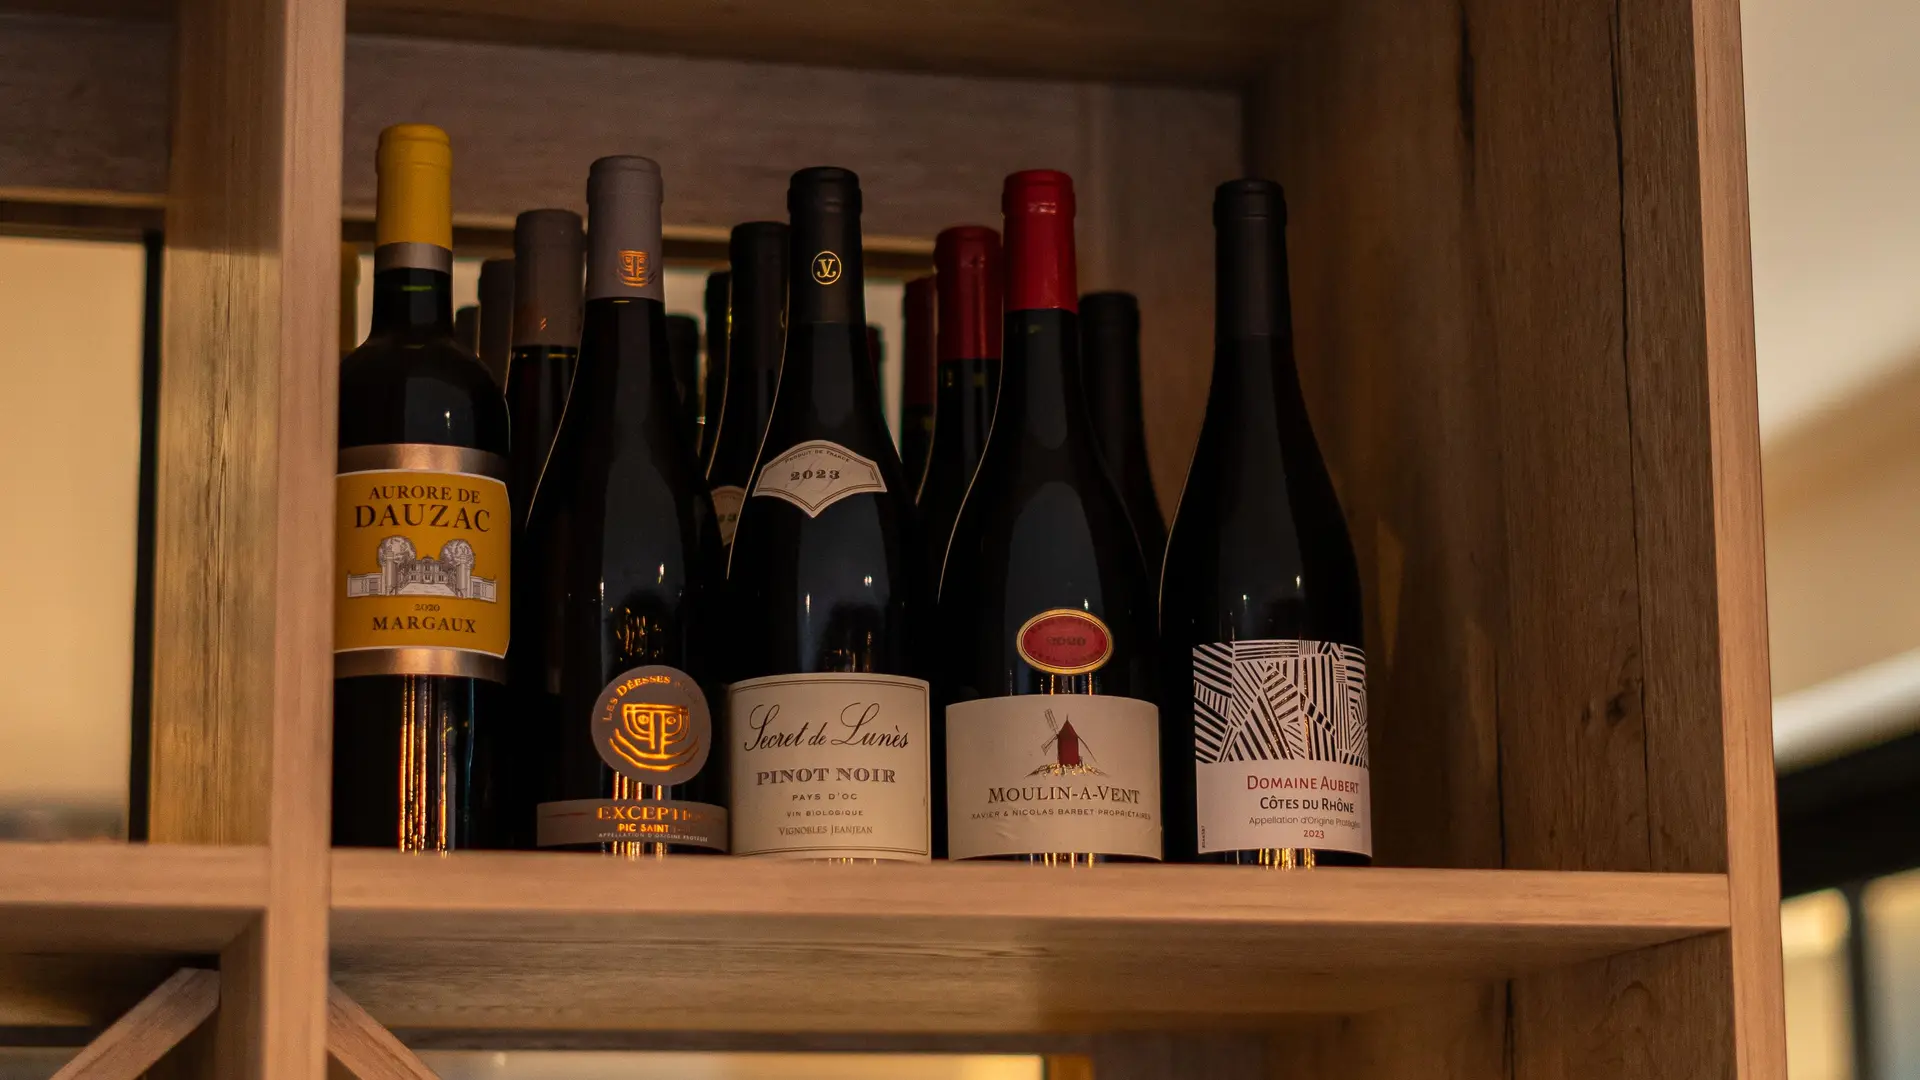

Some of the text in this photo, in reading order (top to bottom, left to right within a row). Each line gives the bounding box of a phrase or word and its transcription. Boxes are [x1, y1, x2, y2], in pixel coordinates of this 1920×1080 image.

[784, 451, 812, 464] PRODUIT
[790, 469, 840, 481] 2023
[368, 485, 481, 504] AURORE DE
[354, 503, 491, 533] DAUZAC
[413, 603, 441, 612] 2020
[372, 615, 477, 634] MARGAUX
[602, 697, 619, 722] LES
[744, 702, 909, 752] Secret de Lunès
[756, 768, 896, 786] PINOT NOIR
[1247, 774, 1360, 794] DOMAINE AUBERT
[987, 785, 1140, 804] MOULIN-A-VENT
[1260, 795, 1355, 813] CÔTES DU RHÔNE
[971, 810, 1000, 820] XAVIER
[1012, 808, 1054, 816] NICOLAS
[1097, 809, 1152, 820] PROPRIÉTAIRES
[1248, 816, 1299, 827] Appellation
[1300, 816, 1334, 827] d'Origine
[617, 823, 637, 833] PIC
[640, 823, 669, 833] SAINT
[778, 825, 873, 837] VIGNOBLES JEANJEAN
[1303, 829, 1325, 839] 2023
